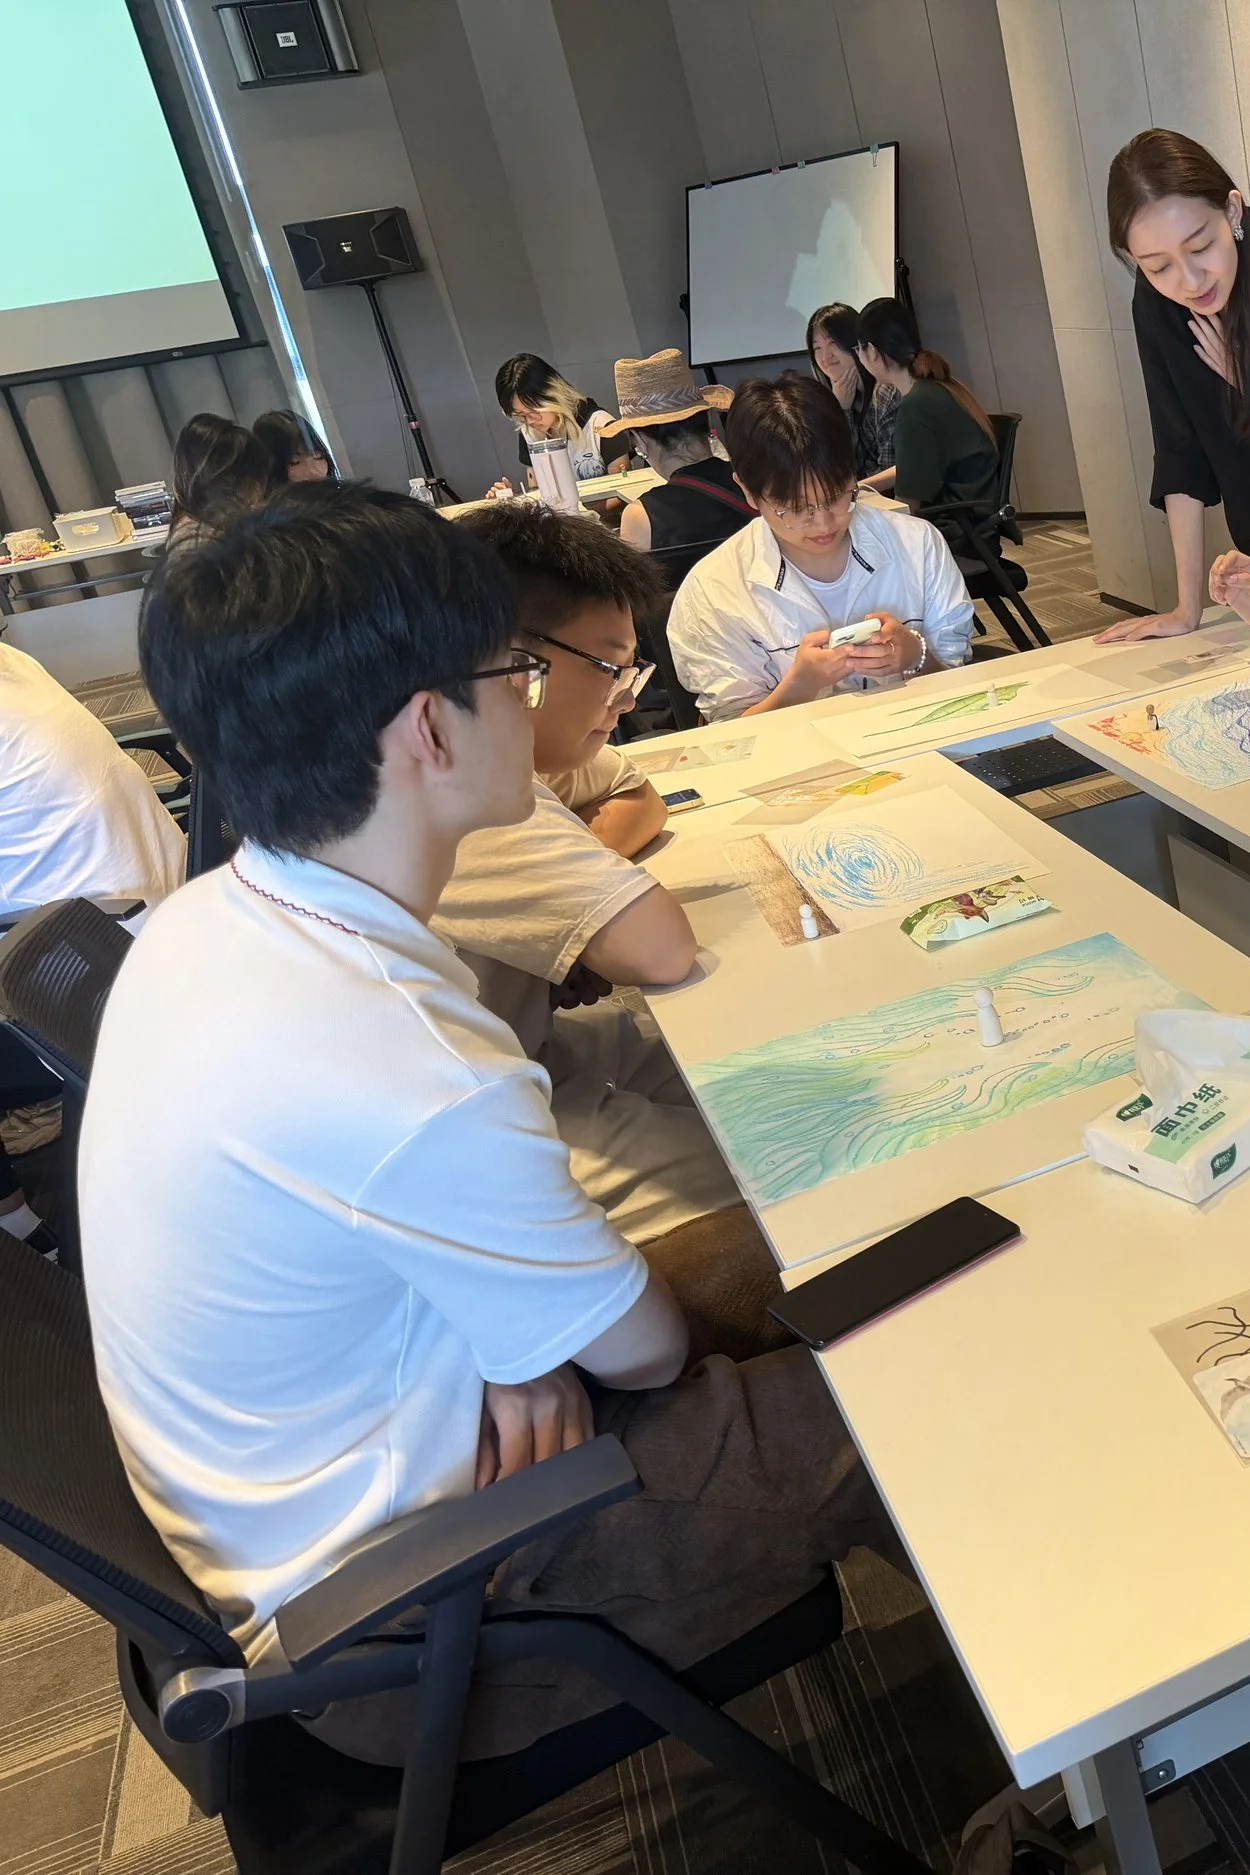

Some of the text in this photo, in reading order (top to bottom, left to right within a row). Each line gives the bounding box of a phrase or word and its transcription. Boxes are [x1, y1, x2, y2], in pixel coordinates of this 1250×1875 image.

[280, 35, 294, 44] JBL
[1150, 1083, 1221, 1137] 面巾纸
